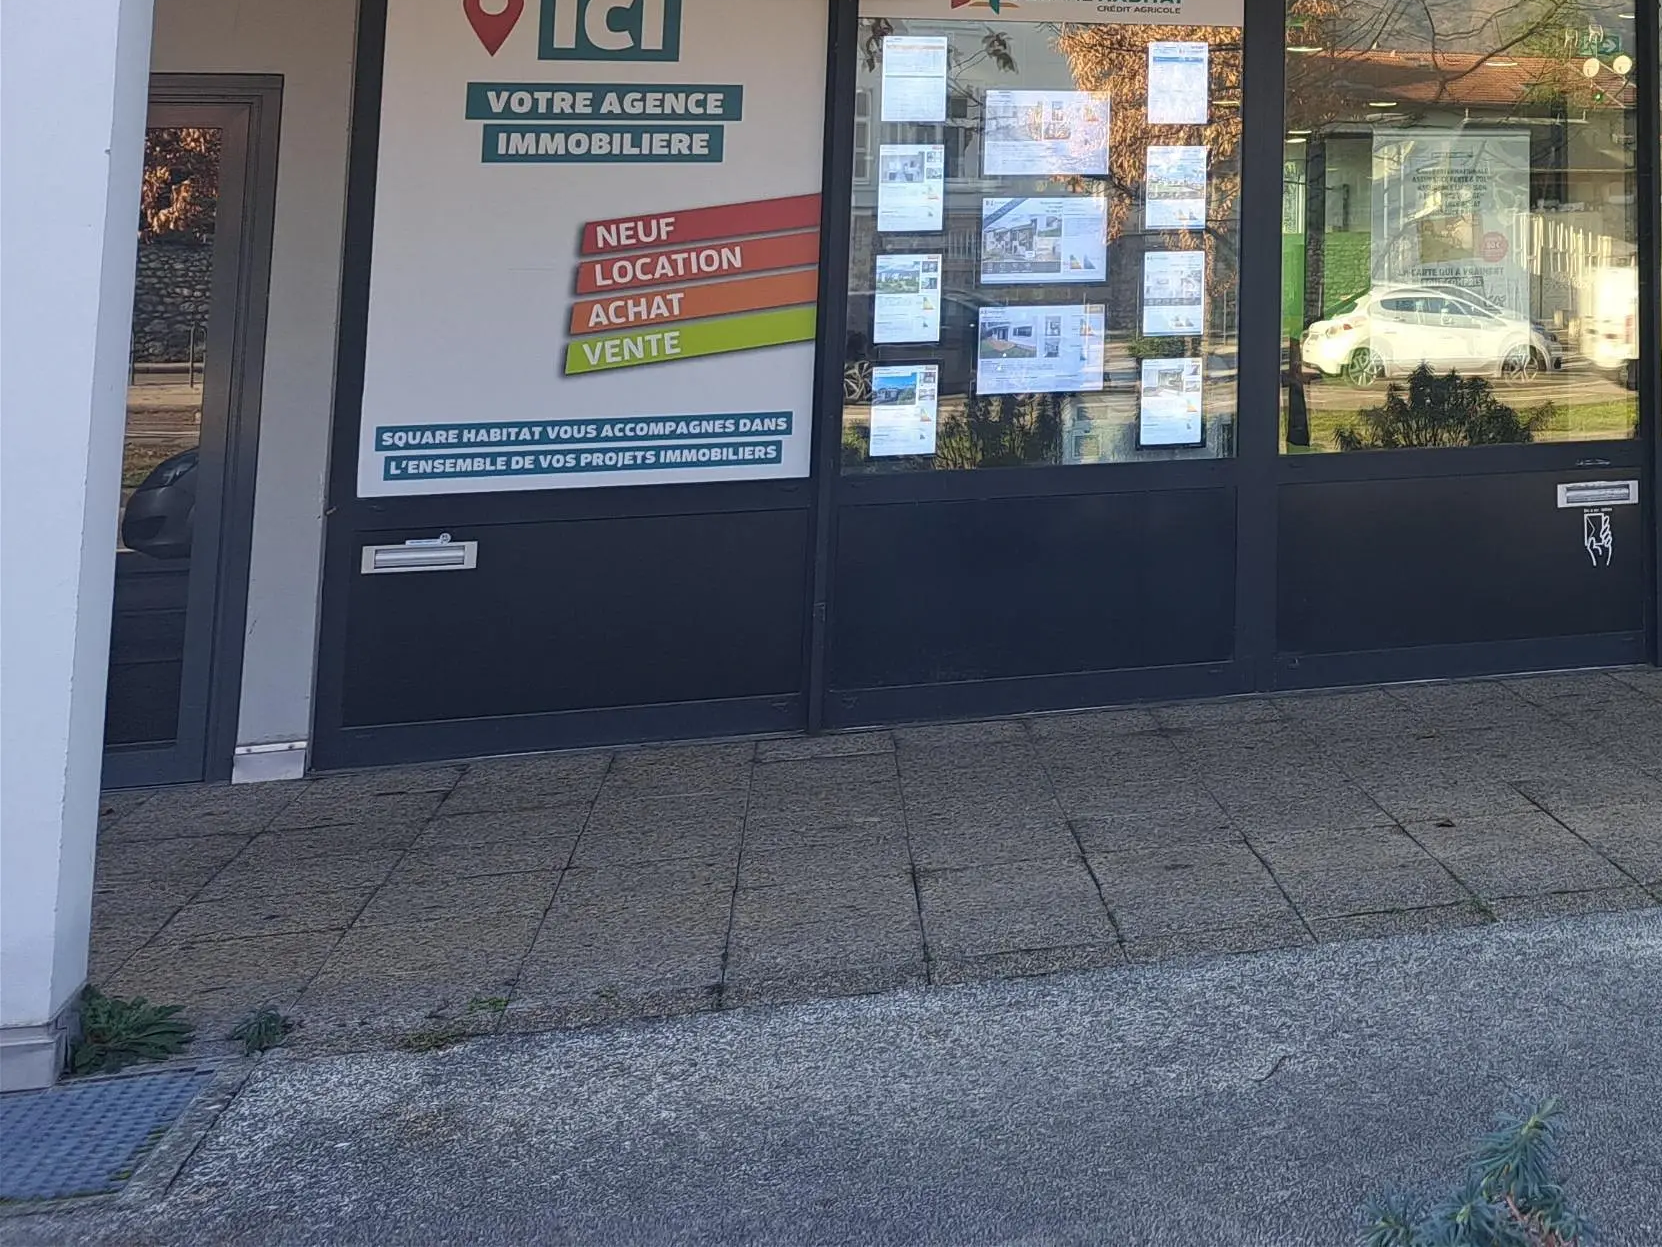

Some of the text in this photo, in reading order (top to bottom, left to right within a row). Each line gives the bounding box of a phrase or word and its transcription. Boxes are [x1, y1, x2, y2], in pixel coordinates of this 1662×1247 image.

[1096, 4, 1181, 14] CRÉDIT AGRICOLE
[487, 90, 724, 115] VOTRE AGENCE
[497, 131, 710, 156] IMMOBILIERE
[595, 216, 676, 248] NEUF
[594, 246, 743, 287] LOCATION
[588, 292, 685, 327] ACHAT
[582, 330, 681, 366] VENTE
[381, 417, 788, 446] SQUARE HABITAT VOUS ACCOMPAGNES DANS
[390, 445, 778, 475] L'ENSEMBLE DE VOS PROJETS IMMOBILIERS
